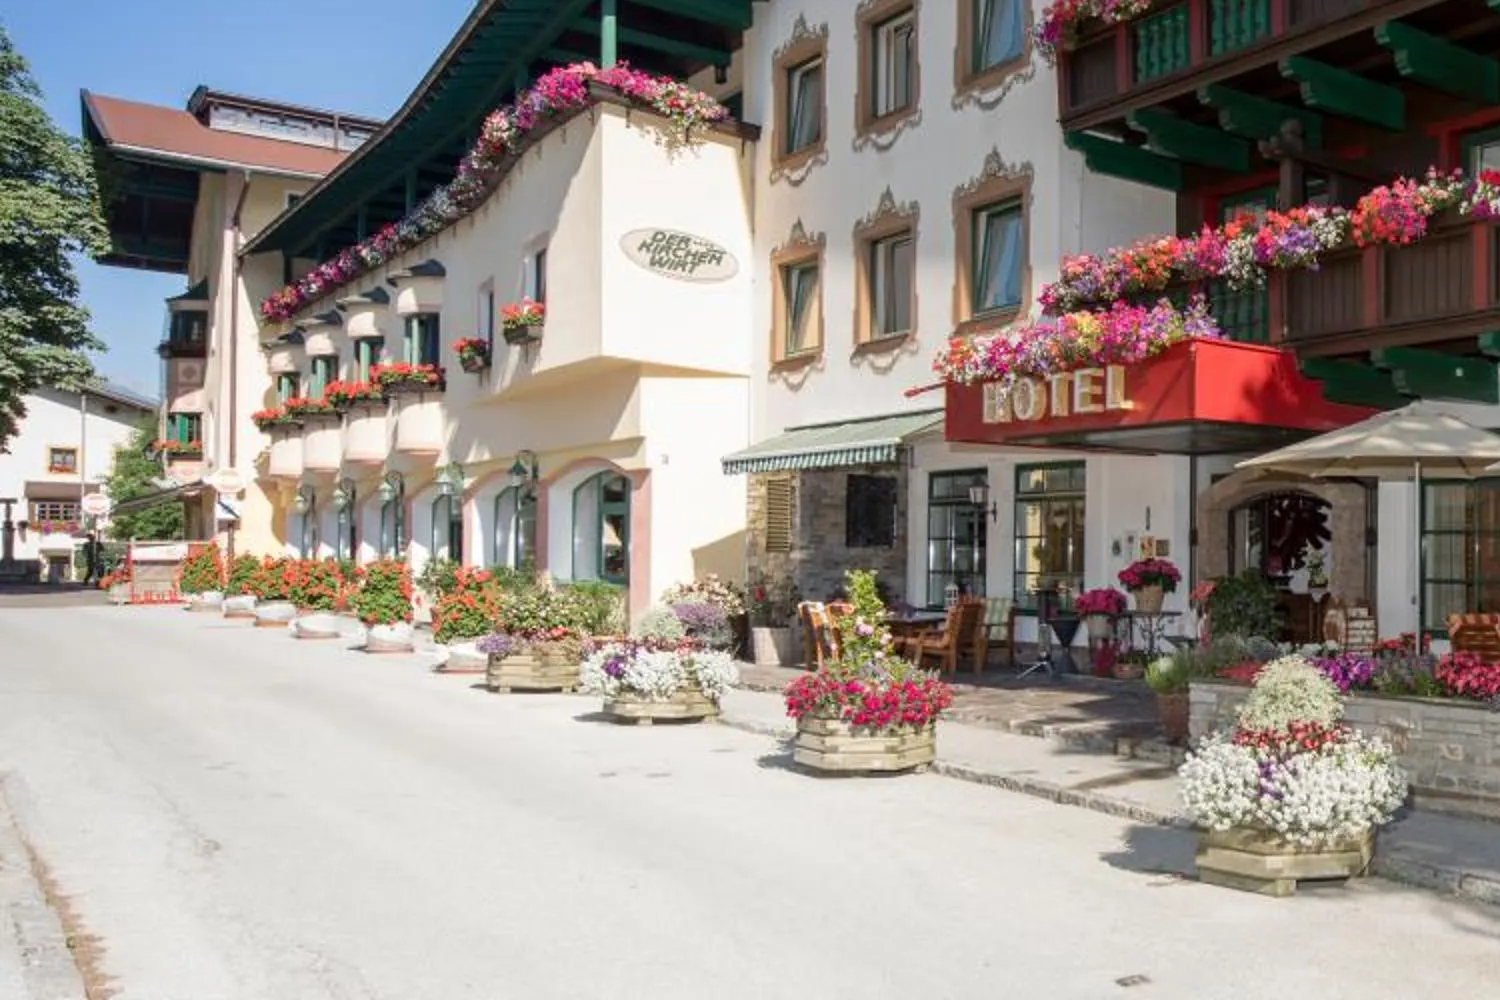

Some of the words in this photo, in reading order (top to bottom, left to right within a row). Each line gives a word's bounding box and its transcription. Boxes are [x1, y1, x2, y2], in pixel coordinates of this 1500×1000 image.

[653, 231, 690, 248] DER
[650, 254, 697, 273] WIRT
[983, 365, 1133, 423] HOTEL
